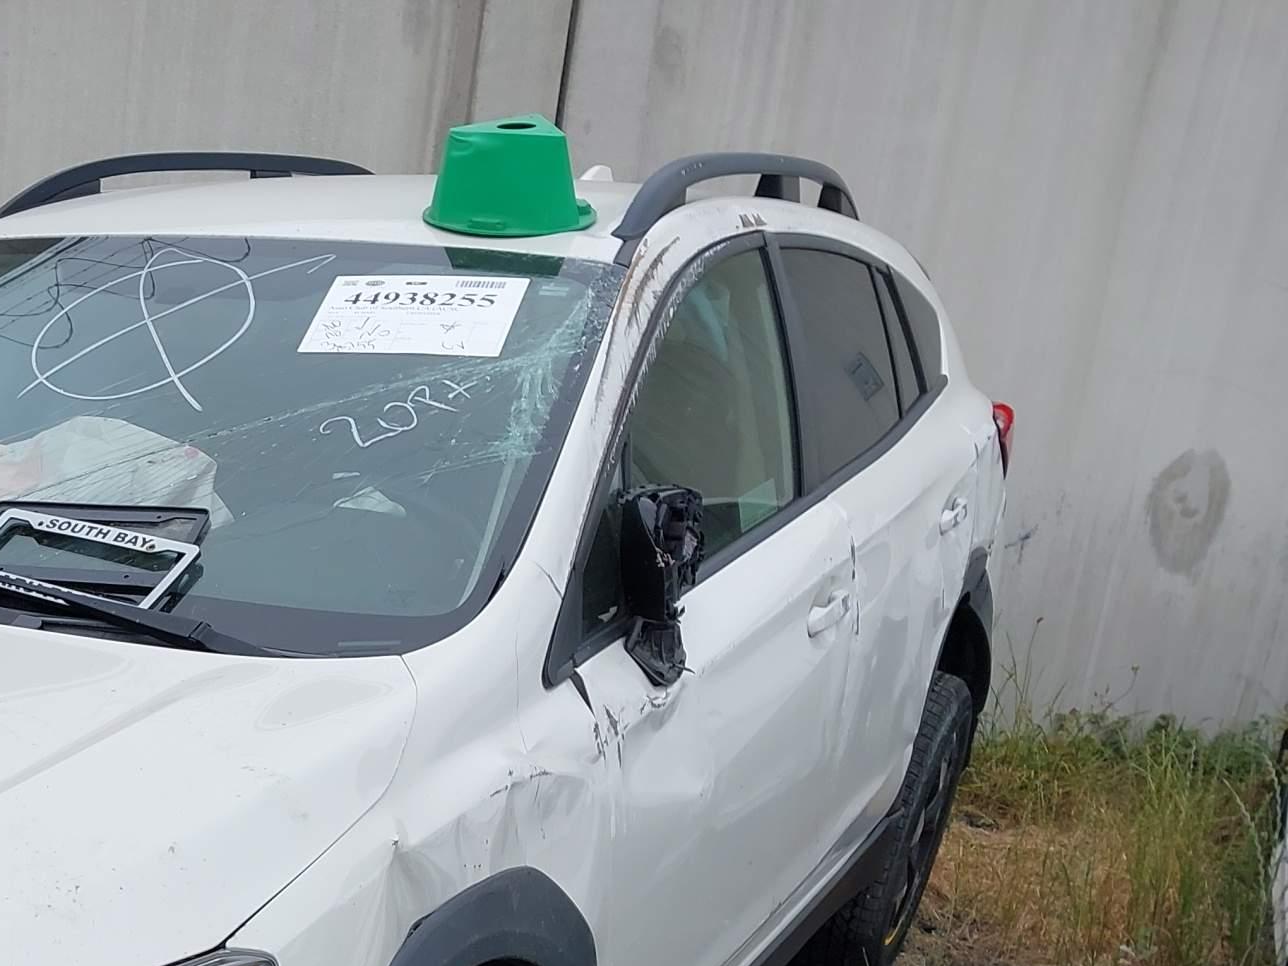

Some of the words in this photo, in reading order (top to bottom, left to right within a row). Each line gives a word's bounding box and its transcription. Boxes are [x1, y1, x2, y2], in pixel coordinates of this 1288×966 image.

[344, 292, 498, 308] 44938255
[46, 519, 111, 539] SOUTH
[113, 531, 153, 548] BAY
